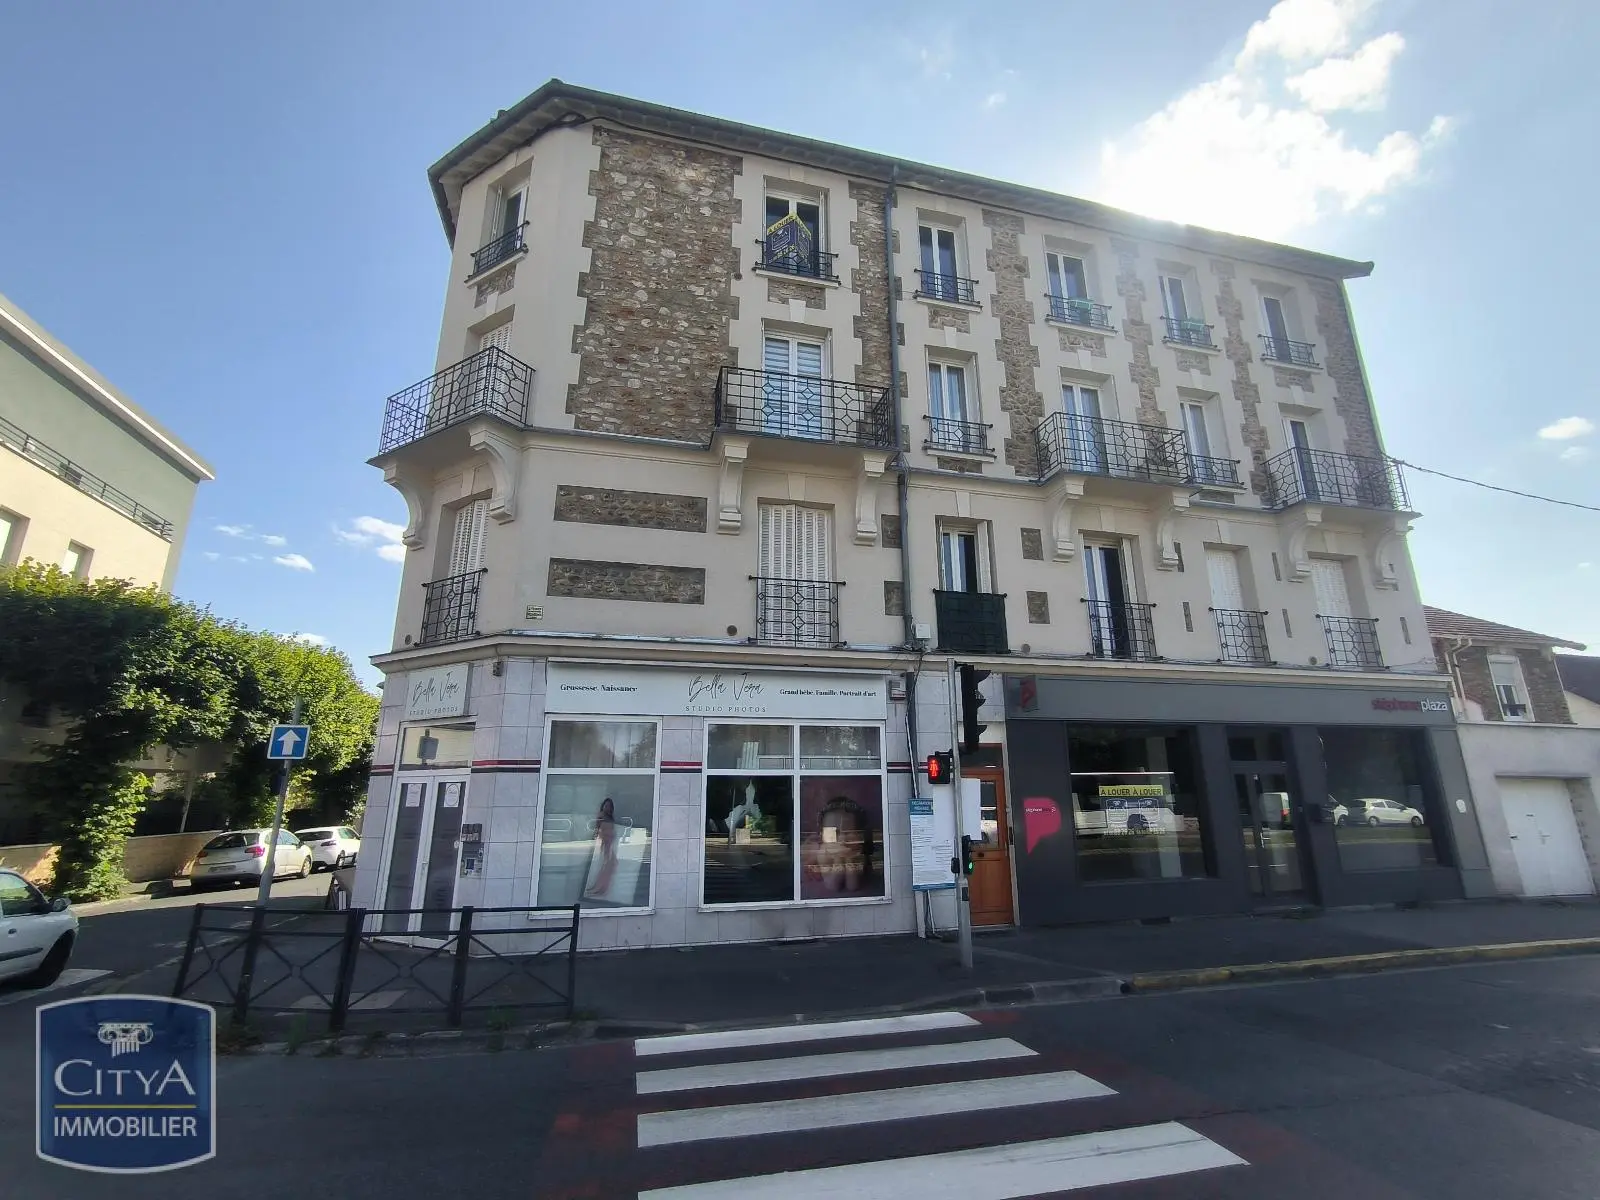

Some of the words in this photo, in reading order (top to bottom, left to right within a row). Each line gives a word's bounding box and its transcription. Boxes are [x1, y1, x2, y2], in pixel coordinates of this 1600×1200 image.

[688, 674, 727, 702] Bella
[733, 671, 765, 701] Vera
[1420, 698, 1448, 712] plaza
[1107, 788, 1131, 796] LOUER
[1139, 788, 1162, 796] LOUER
